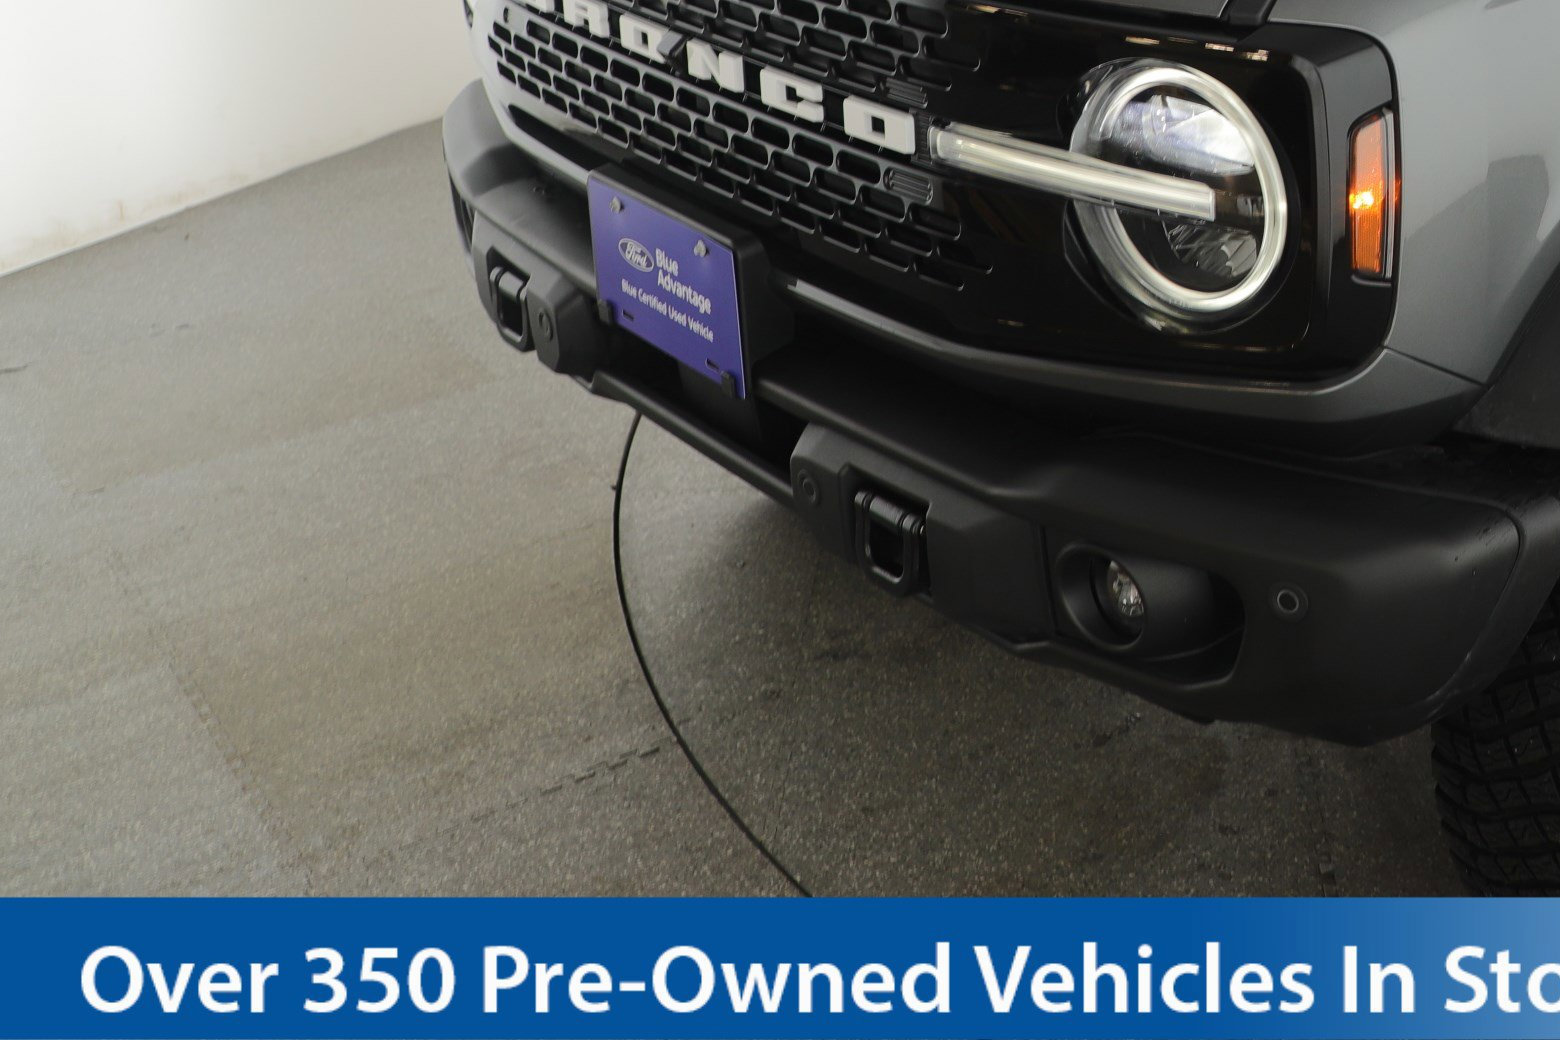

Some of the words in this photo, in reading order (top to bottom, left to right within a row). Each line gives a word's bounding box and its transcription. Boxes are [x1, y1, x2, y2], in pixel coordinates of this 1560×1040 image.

[623, 241, 650, 268] Ford
[655, 248, 679, 277] Blue
[621, 278, 637, 299] Blue
[638, 288, 667, 316] Certified
[668, 305, 687, 327] Used
[687, 315, 714, 343] Vehicle
[657, 269, 712, 315] Advantage
